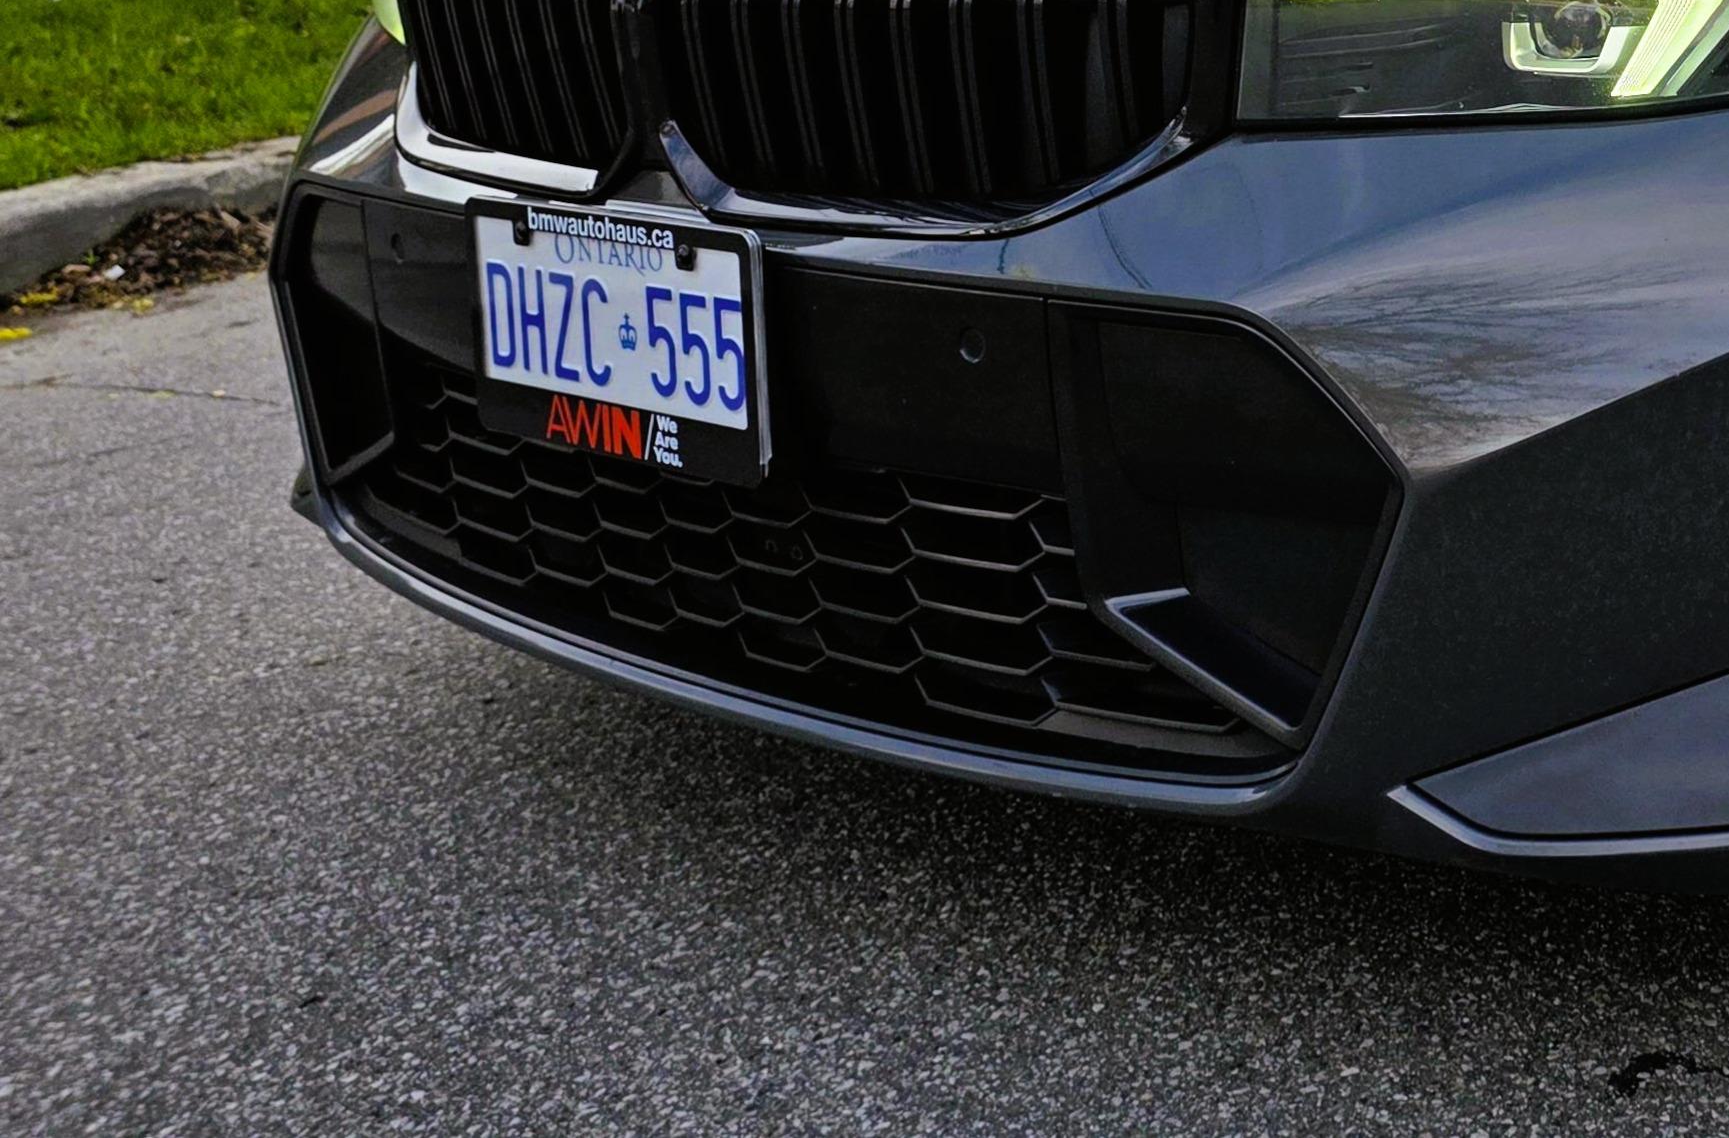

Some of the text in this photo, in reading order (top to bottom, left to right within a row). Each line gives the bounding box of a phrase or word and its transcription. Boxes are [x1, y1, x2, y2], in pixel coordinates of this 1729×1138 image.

[527, 205, 674, 249] bmwautohaus.ca
[487, 261, 745, 411] DHZC 555
[546, 394, 642, 460] AWIN
[656, 414, 678, 434] We
[653, 446, 683, 468] You.
[654, 431, 679, 451] Are
